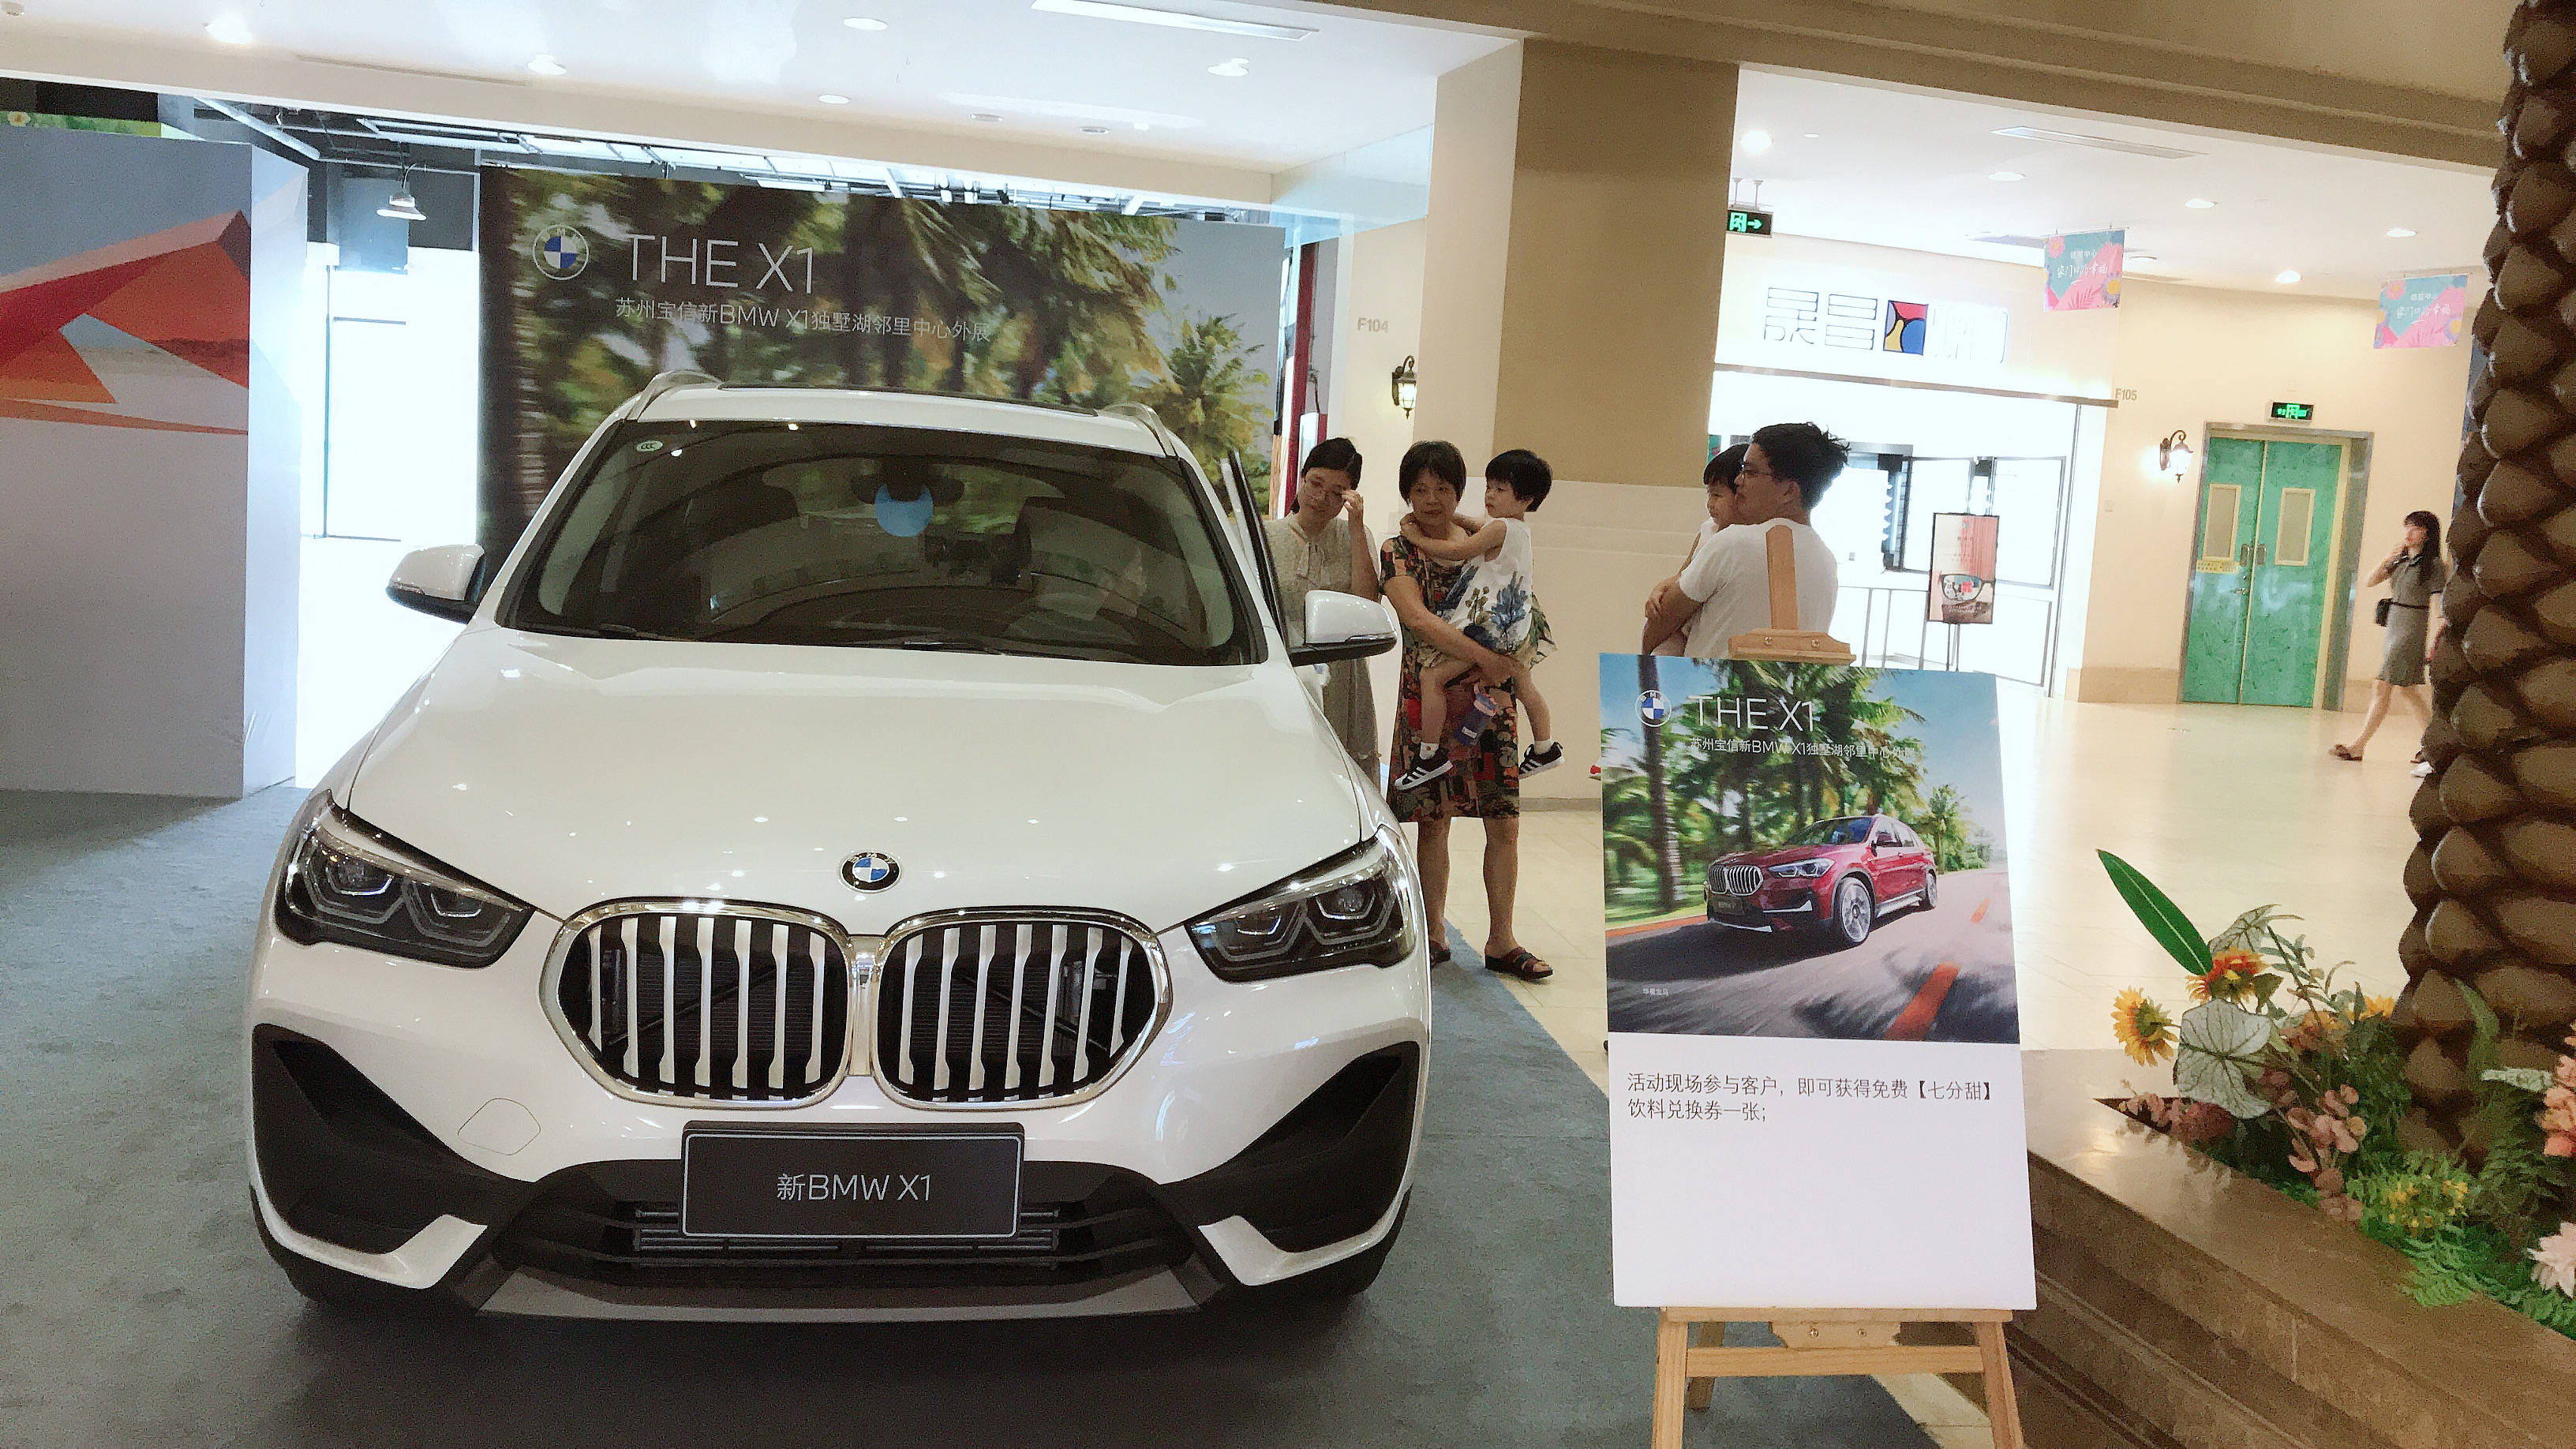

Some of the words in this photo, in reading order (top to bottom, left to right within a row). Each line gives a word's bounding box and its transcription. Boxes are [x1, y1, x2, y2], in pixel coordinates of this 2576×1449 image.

[620, 234, 739, 288] THE
[755, 242, 814, 294] X1
[616, 297, 779, 328] 苏州宝信新BMW
[785, 307, 991, 343] X1独墅湖邻里中心外展
[1357, 316, 1389, 332] F104
[2115, 388, 2137, 401] F105
[1687, 695, 1769, 730] THE
[1779, 700, 1814, 732] X1
[1627, 1072, 1994, 1102] 活动现场参与客户，即可获得免费【七分甜】
[777, 1173, 889, 1201] 新BMW
[897, 1174, 931, 1201] X1
